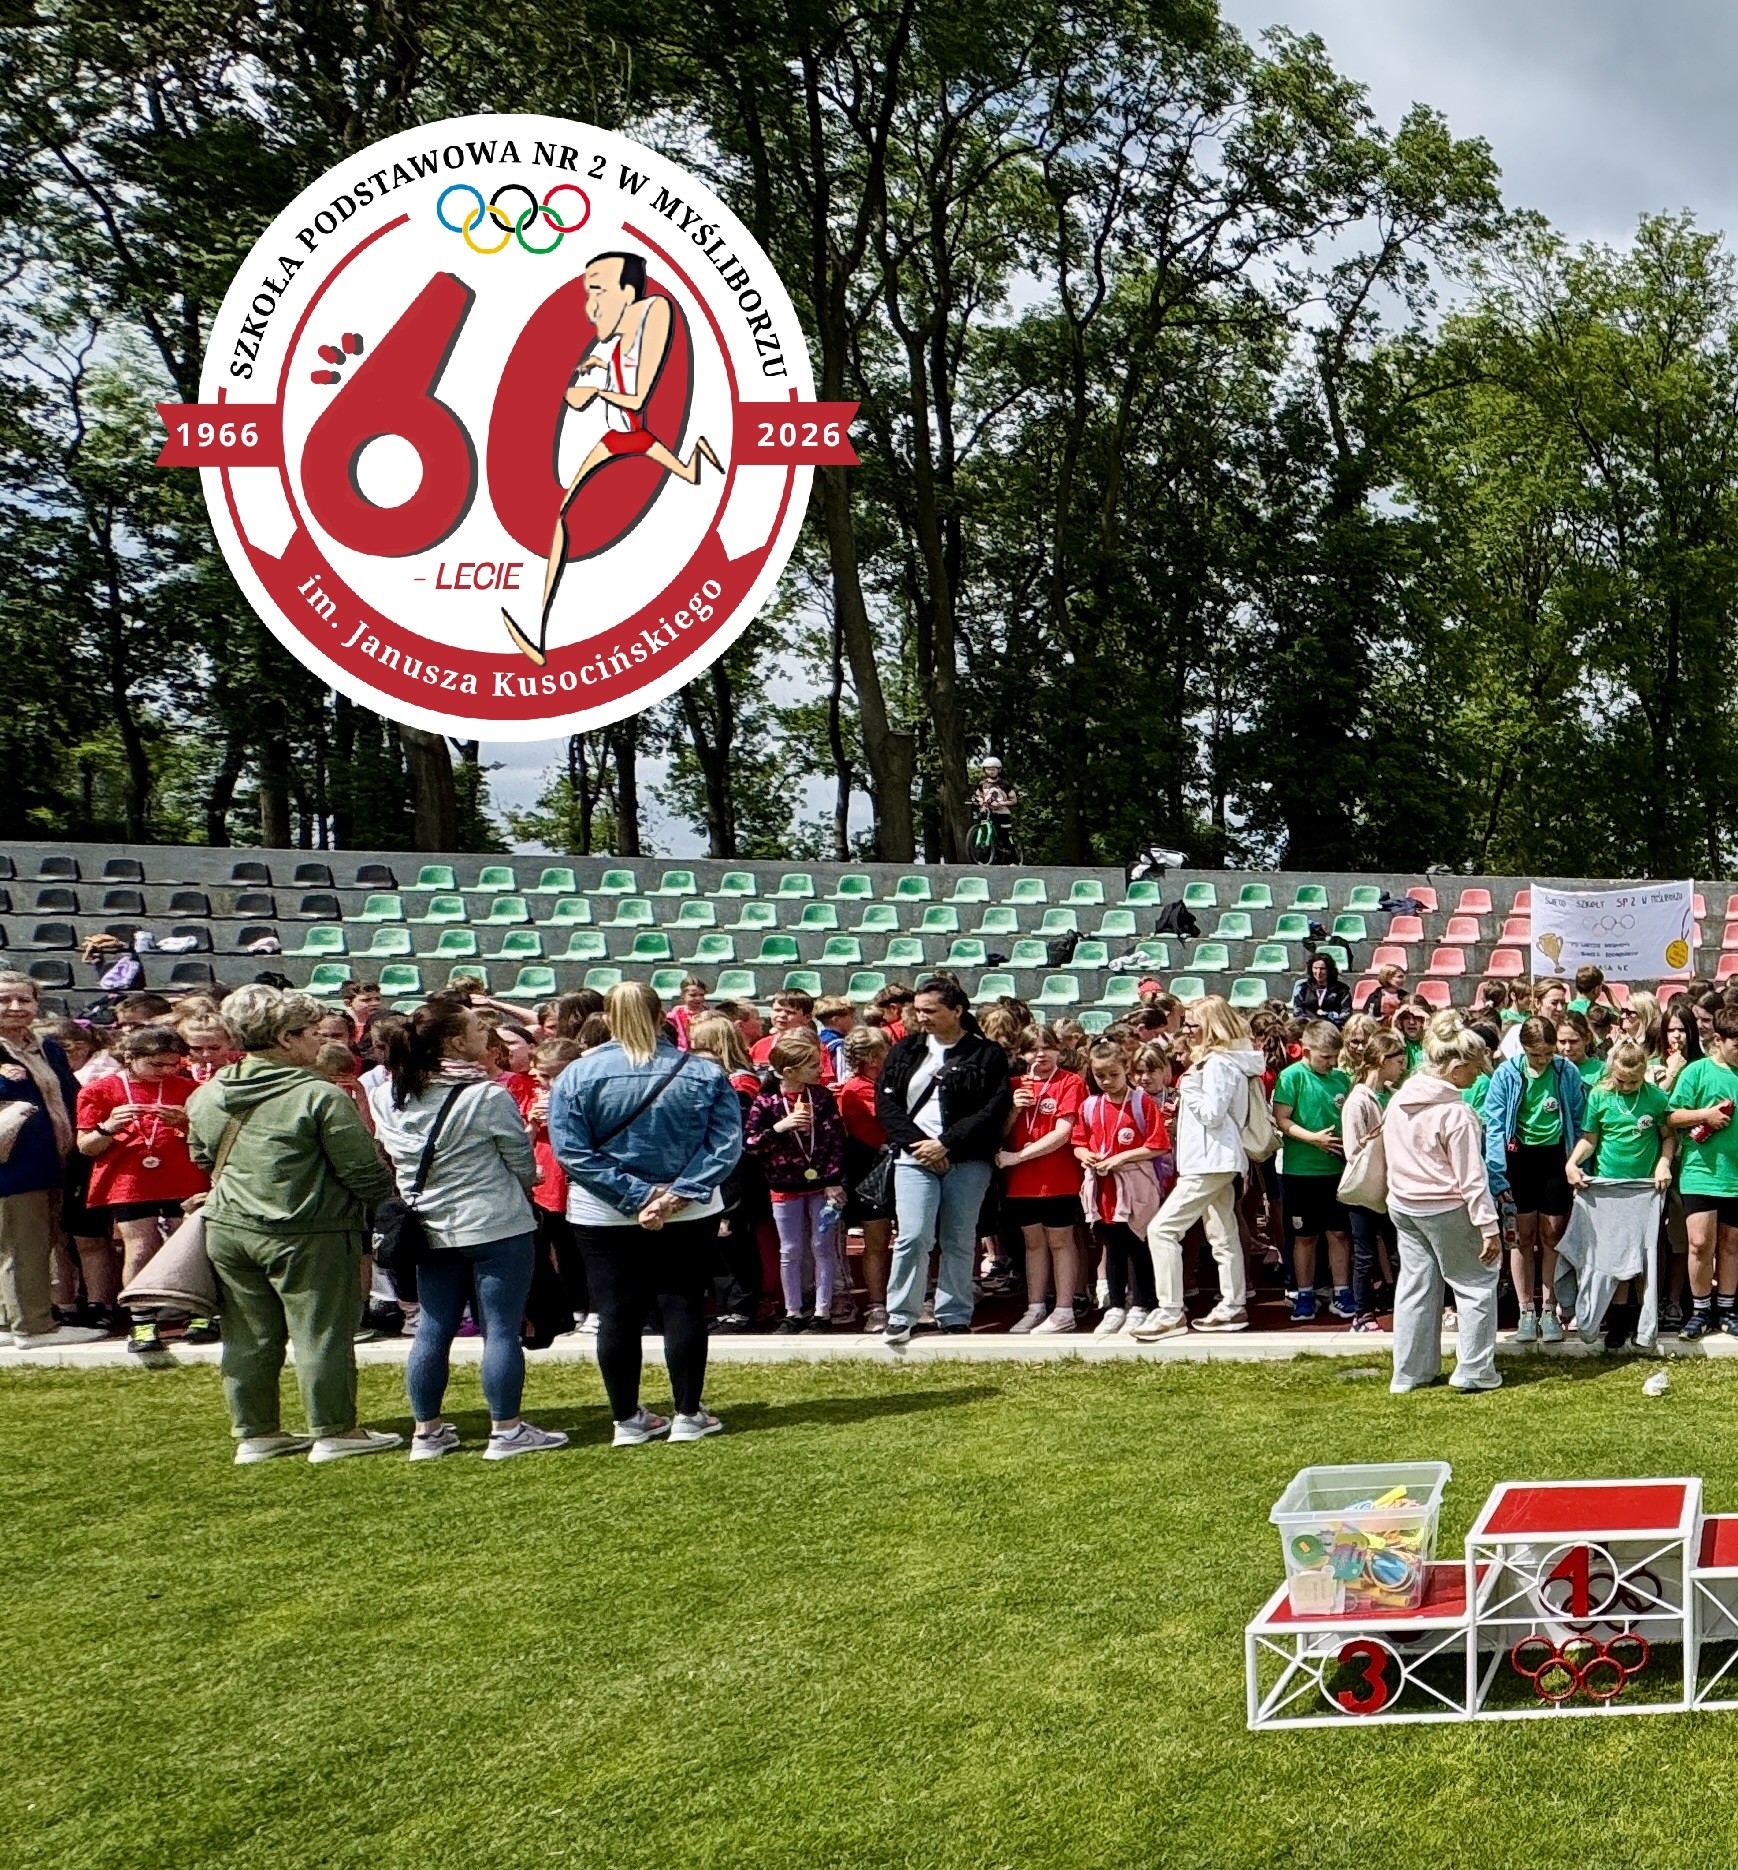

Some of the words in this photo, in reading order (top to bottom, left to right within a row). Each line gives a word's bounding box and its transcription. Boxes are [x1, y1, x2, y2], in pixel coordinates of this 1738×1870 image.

[1616, 897, 1629, 907] SP
[1550, 1546, 1588, 1617] 1
[1337, 1640, 1387, 1713] 3
